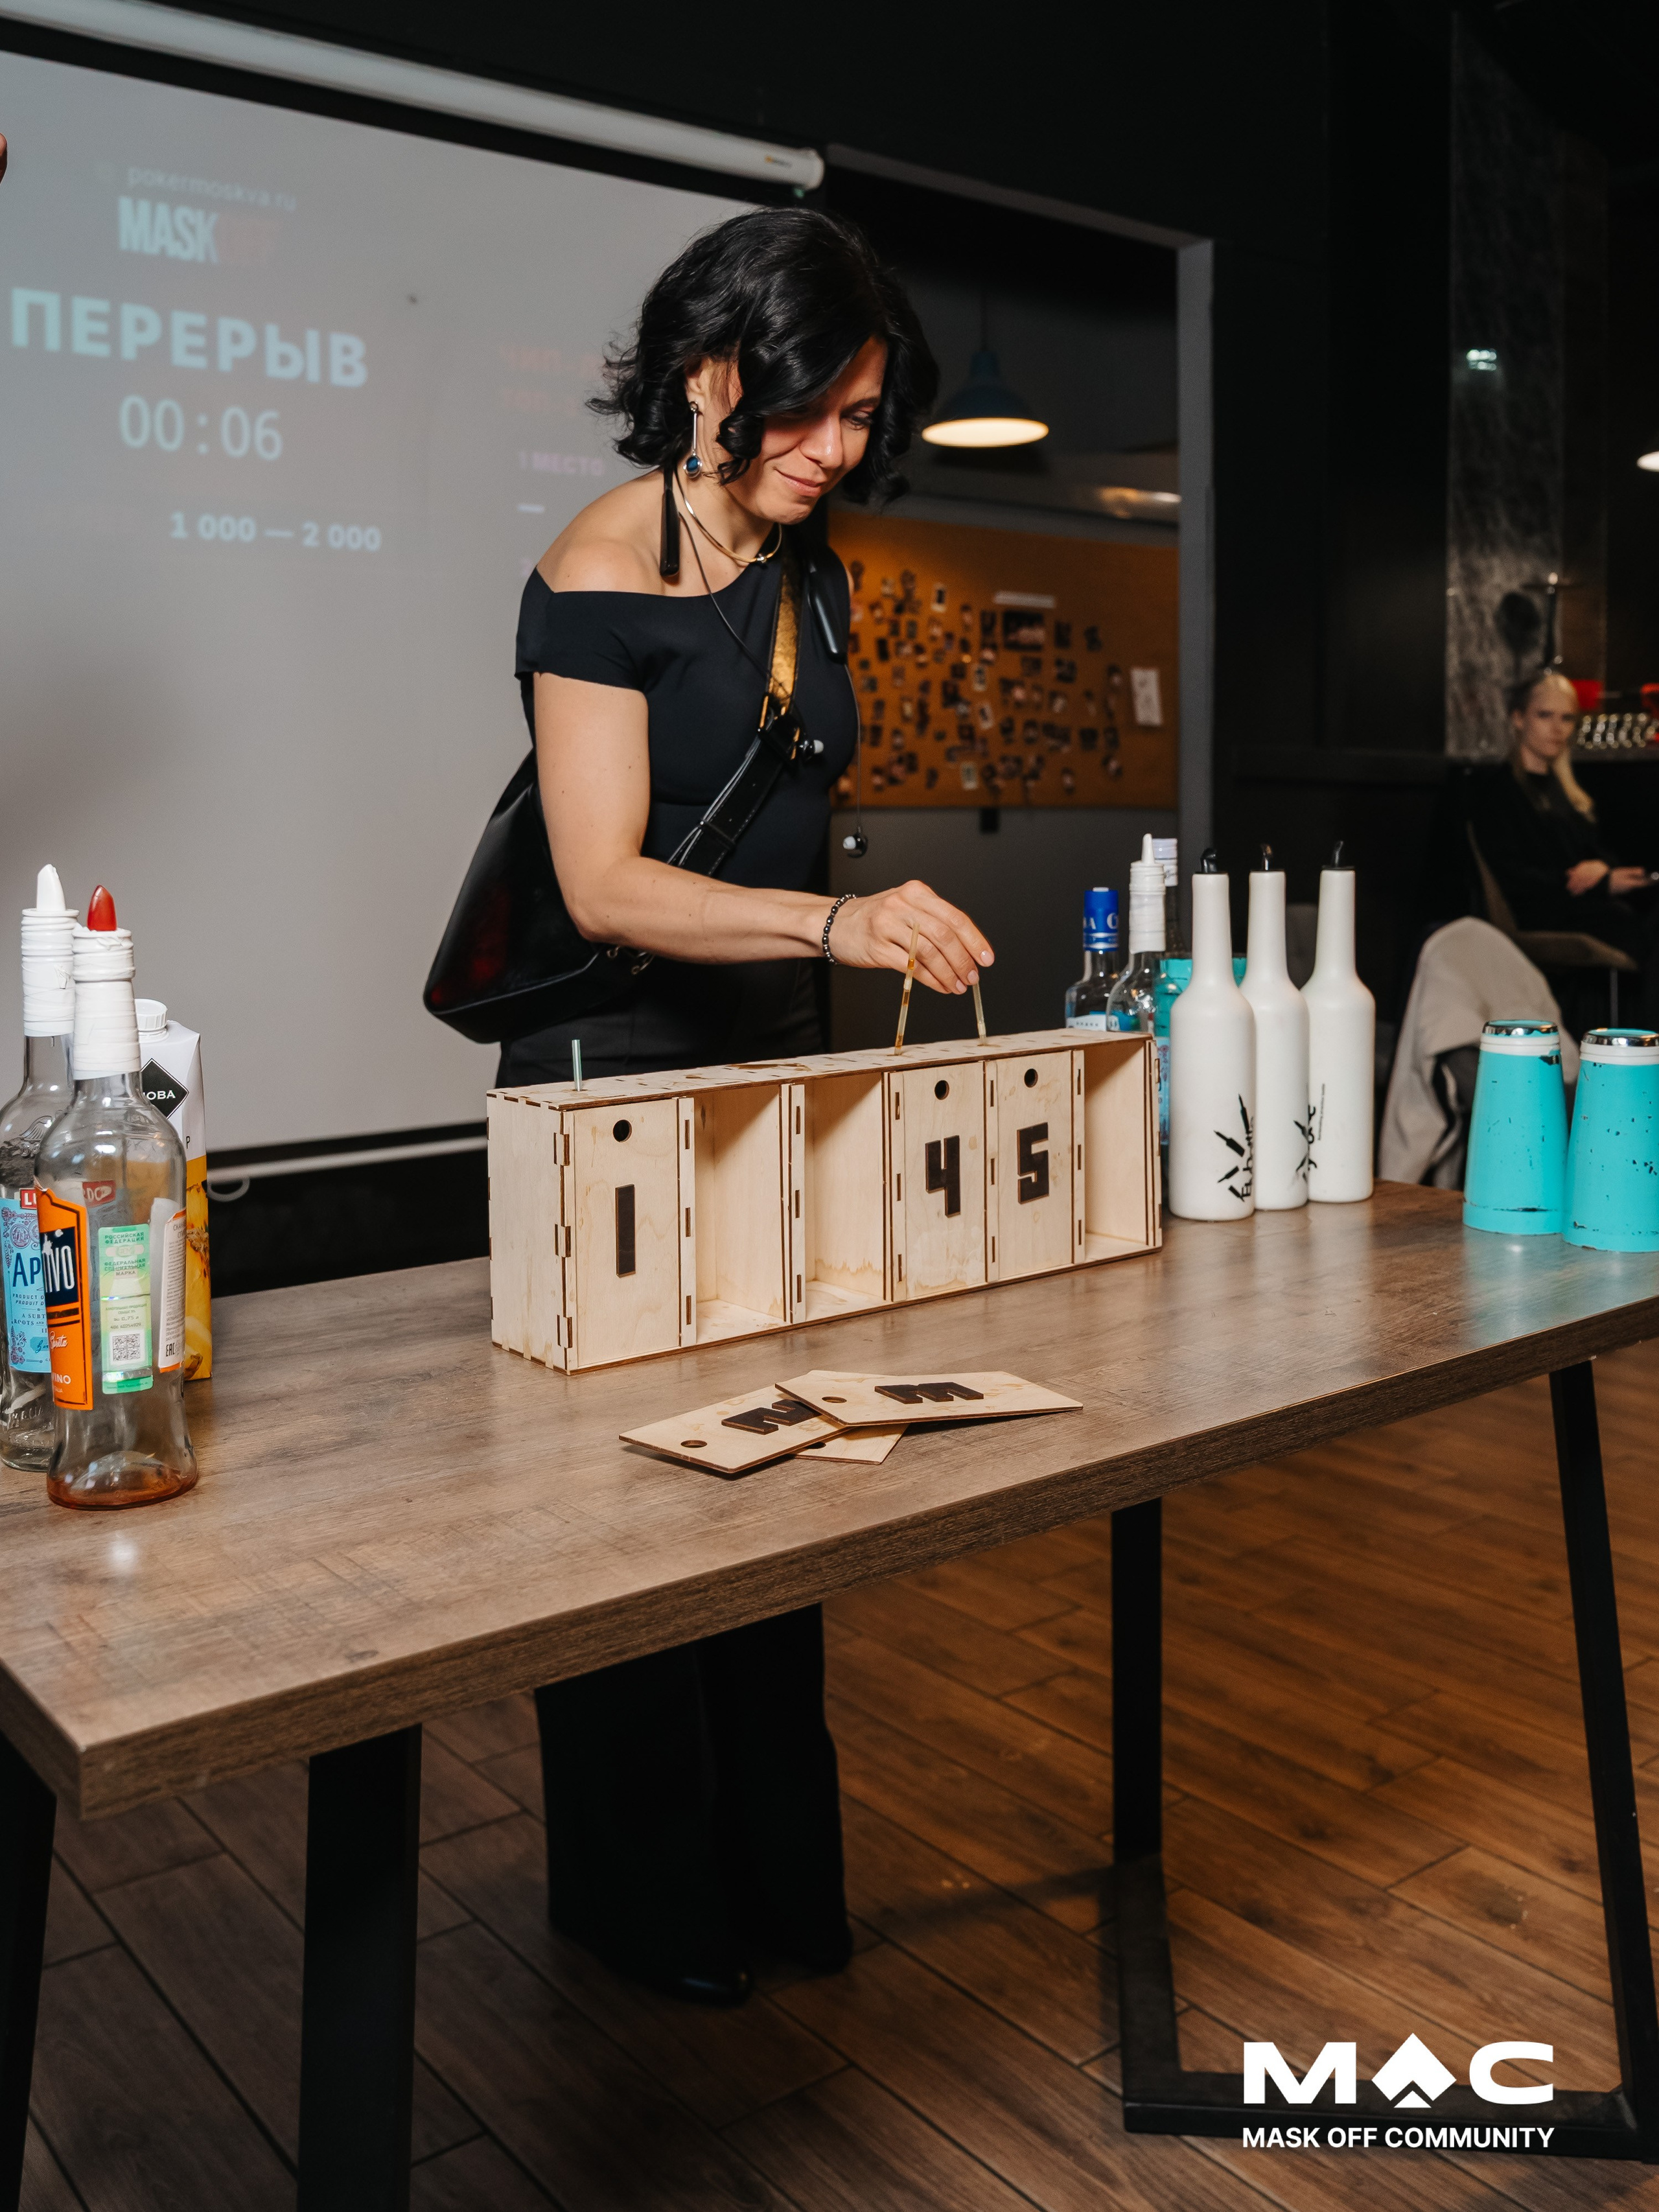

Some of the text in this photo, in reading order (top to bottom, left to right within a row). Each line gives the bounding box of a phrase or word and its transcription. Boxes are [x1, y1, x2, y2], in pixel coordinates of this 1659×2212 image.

[118, 196, 219, 264] MASK
[11, 286, 368, 388] ПЕРЕРЫВ
[119, 395, 283, 461] 00:06
[925, 1135, 960, 1218] 4
[1016, 1122, 1050, 1204] 5
